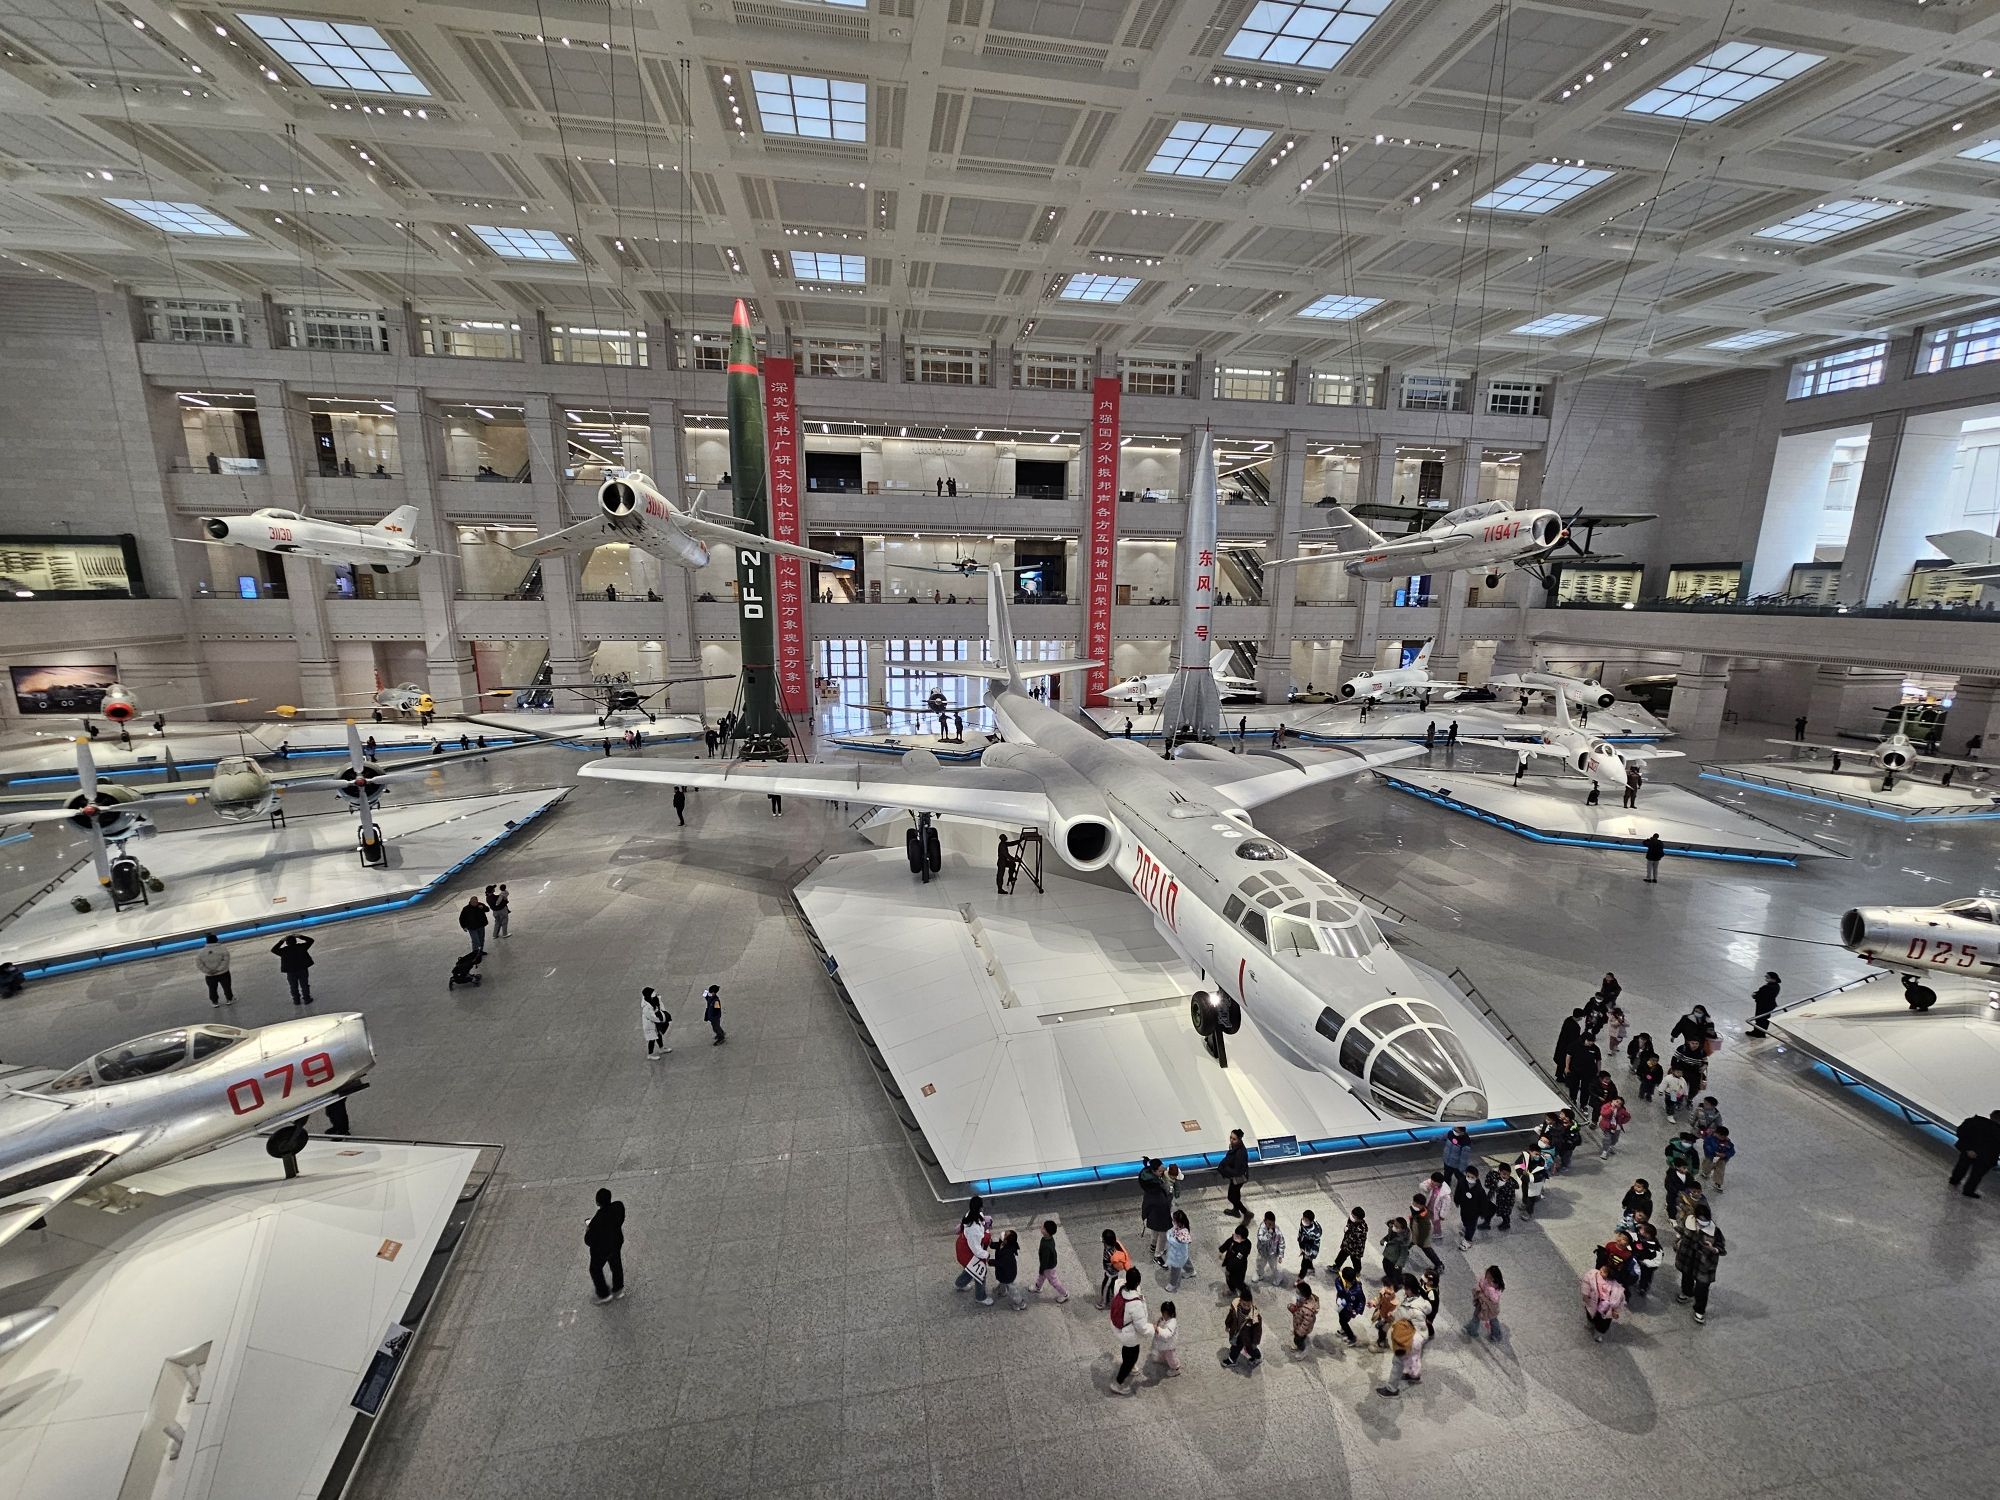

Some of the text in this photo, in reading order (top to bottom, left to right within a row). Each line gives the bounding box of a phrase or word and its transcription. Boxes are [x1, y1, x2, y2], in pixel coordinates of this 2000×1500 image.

[268, 526, 292, 541] 31130
[1484, 521, 1520, 543] 71947
[741, 550, 764, 619] DF-2
[1194, 549, 1214, 642] 东风一号
[1132, 845, 1178, 934] 20210
[1906, 937, 1978, 968] 025
[226, 1052, 335, 1115] 079
